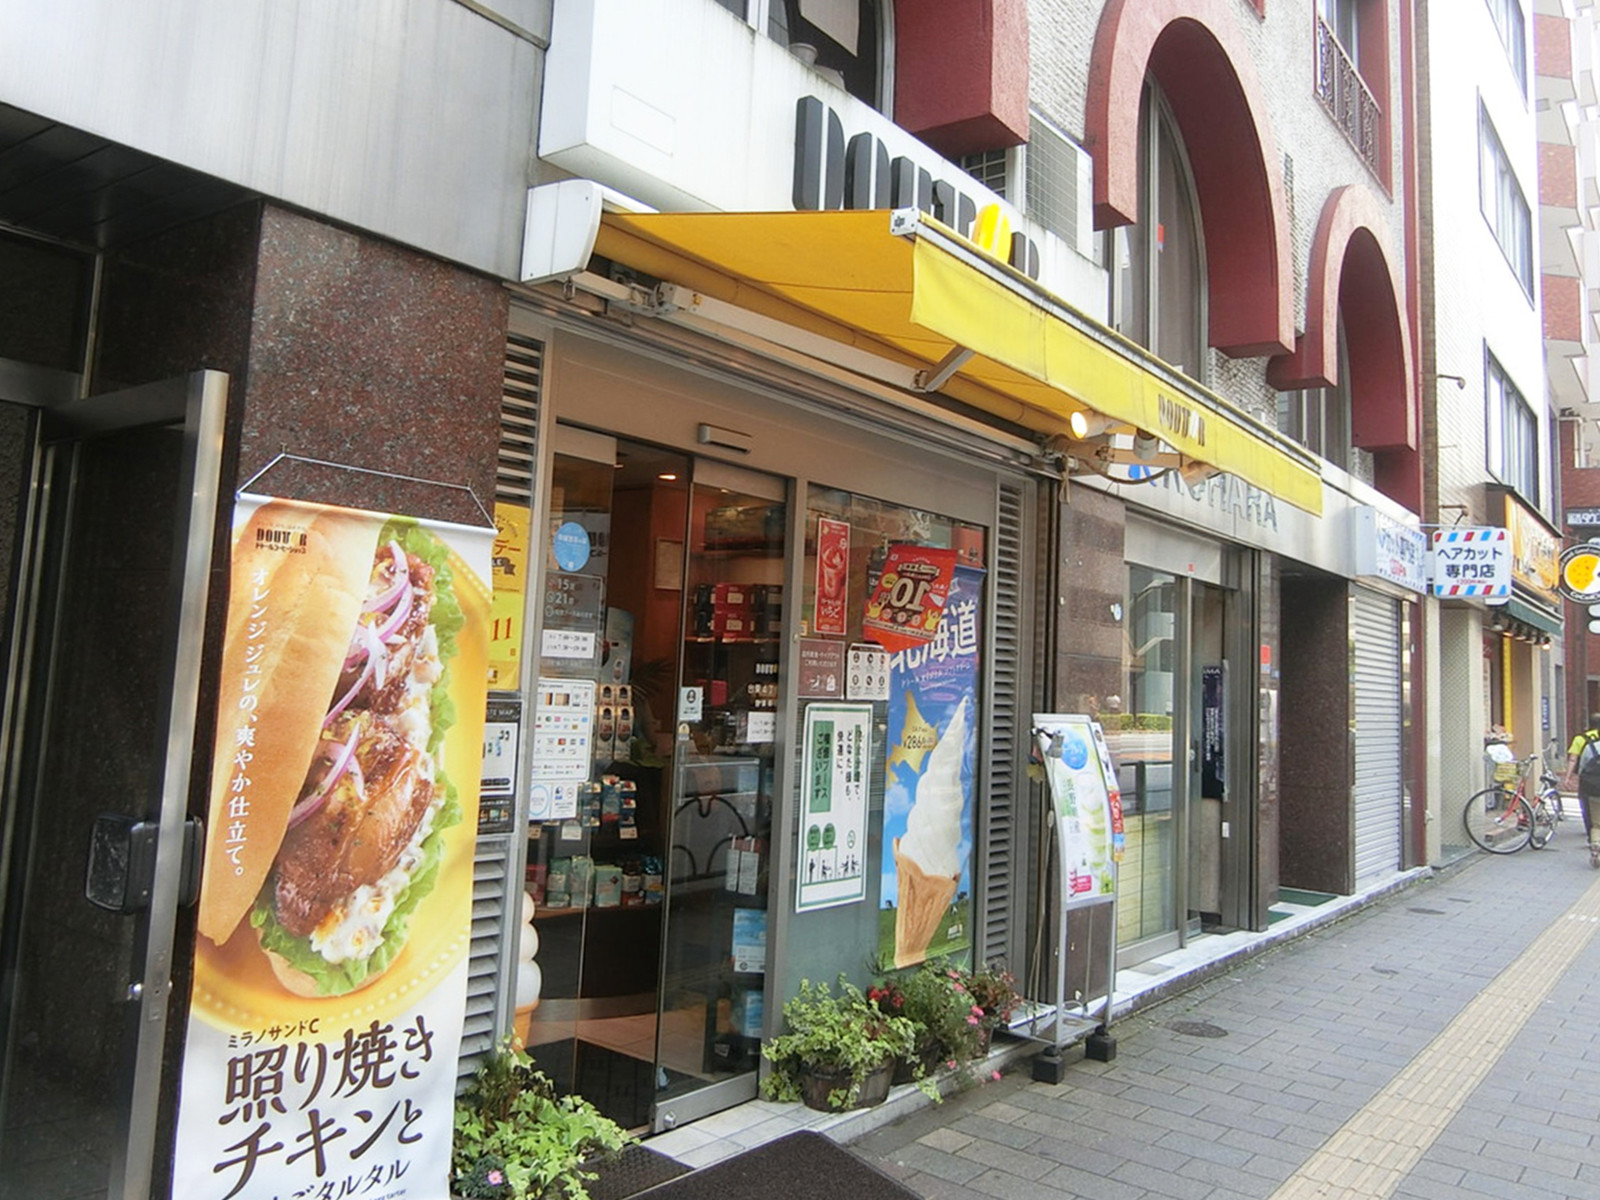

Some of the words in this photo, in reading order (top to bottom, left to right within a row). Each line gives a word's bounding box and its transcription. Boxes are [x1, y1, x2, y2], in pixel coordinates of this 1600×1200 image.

[1158, 393, 1205, 447] DOUTOR
[256, 527, 307, 547] DOUTOR
[1437, 547, 1503, 560] ヘアカット
[1446, 563, 1496, 579] 専門店
[225, 567, 270, 877] オレンジジュレの、爽やか仕立て。
[227, 1018, 320, 1049] ミラノサンドC
[218, 1015, 435, 1125] 照り焼き
[212, 1099, 423, 1200] チキンと
